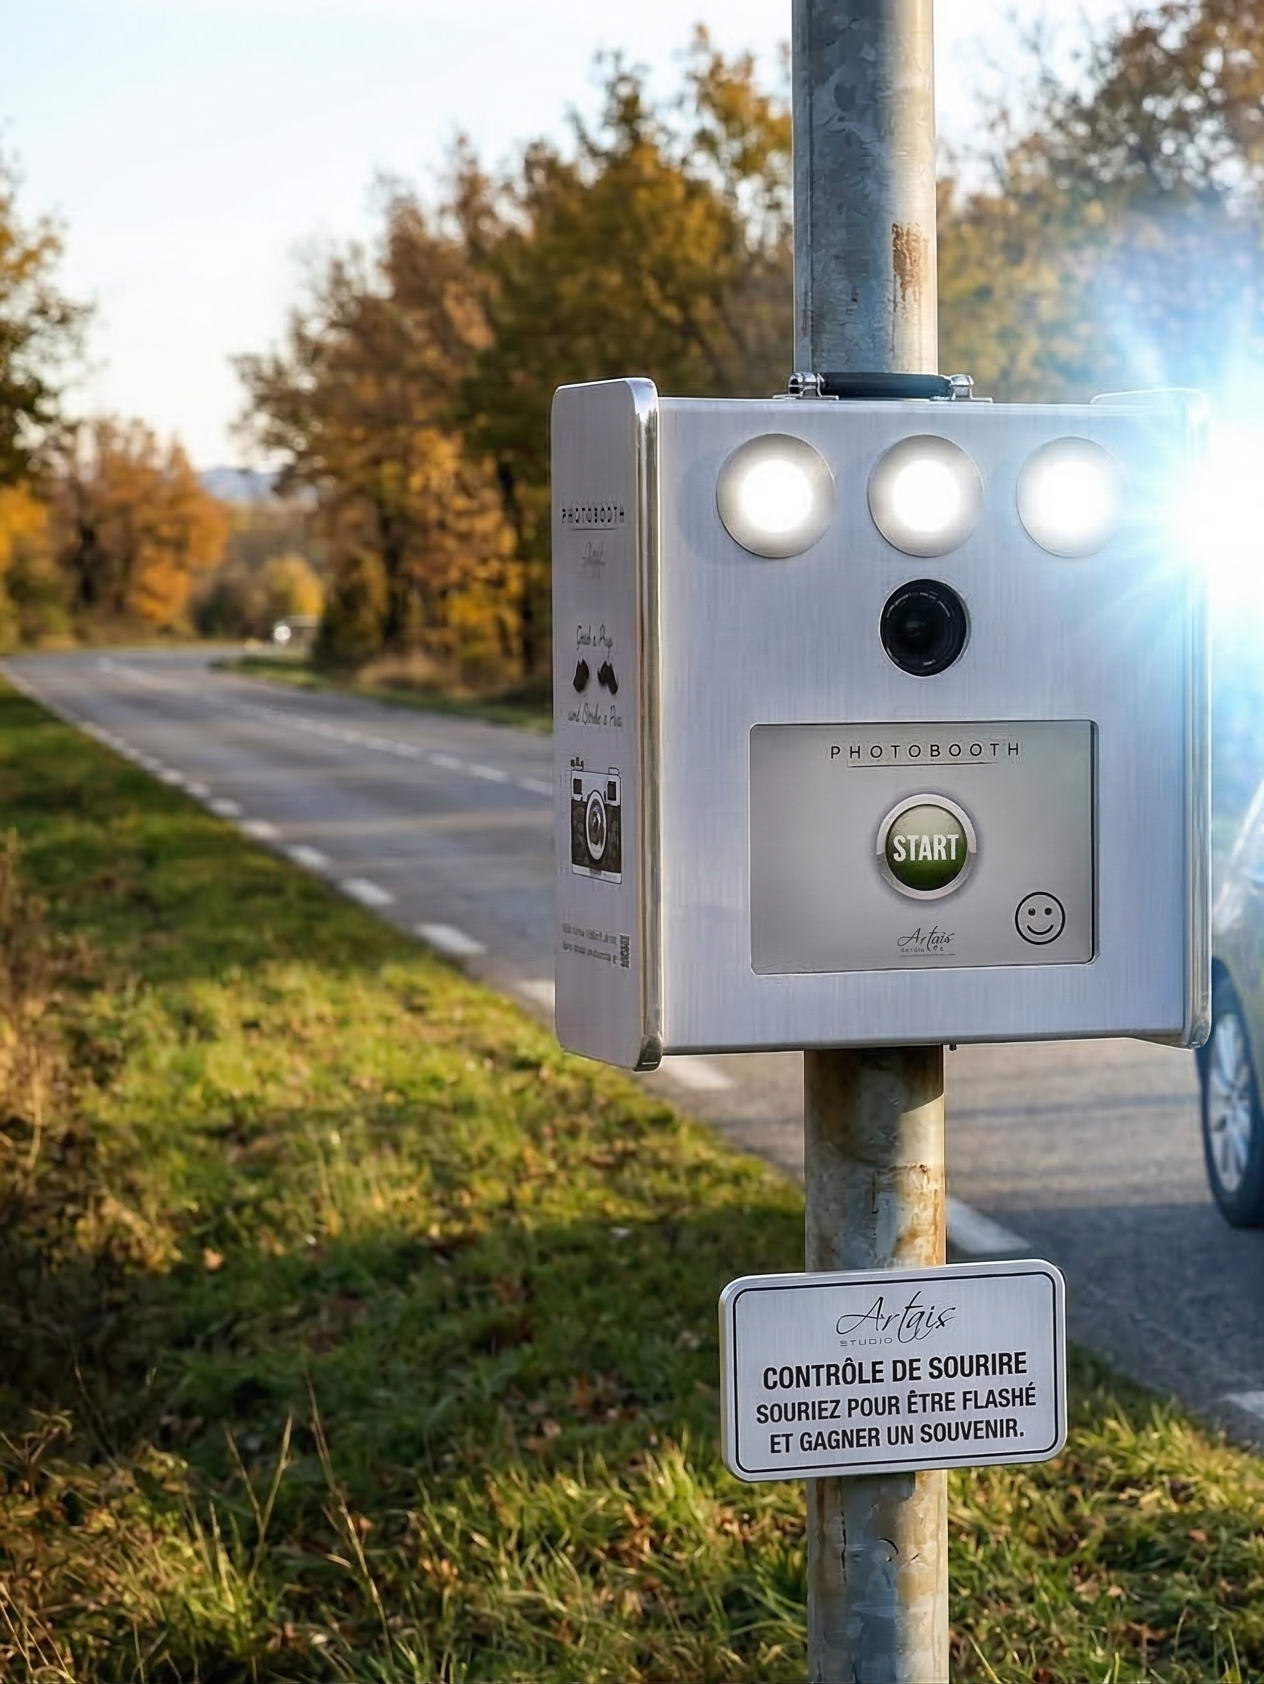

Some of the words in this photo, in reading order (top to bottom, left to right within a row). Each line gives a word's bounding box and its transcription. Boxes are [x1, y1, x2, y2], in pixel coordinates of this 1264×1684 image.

[830, 743, 1020, 760] PHOTOBOOTH
[893, 834, 960, 862] START
[836, 1291, 957, 1344] Artais
[839, 1337, 893, 1347] STUDIO
[763, 1357, 885, 1390] CONTRÔLE
[892, 1358, 922, 1382] DE
[928, 1351, 1027, 1380] SOURIRE
[756, 1399, 842, 1424] SOURIEZ
[847, 1396, 901, 1418] POUR
[907, 1389, 956, 1414] ÊTRE
[962, 1381, 1037, 1410] FLASHÉ
[770, 1433, 794, 1453] ET
[799, 1427, 881, 1451] GAGNER
[887, 1425, 915, 1446] UN
[920, 1417, 1025, 1443] SOUVENIR.
